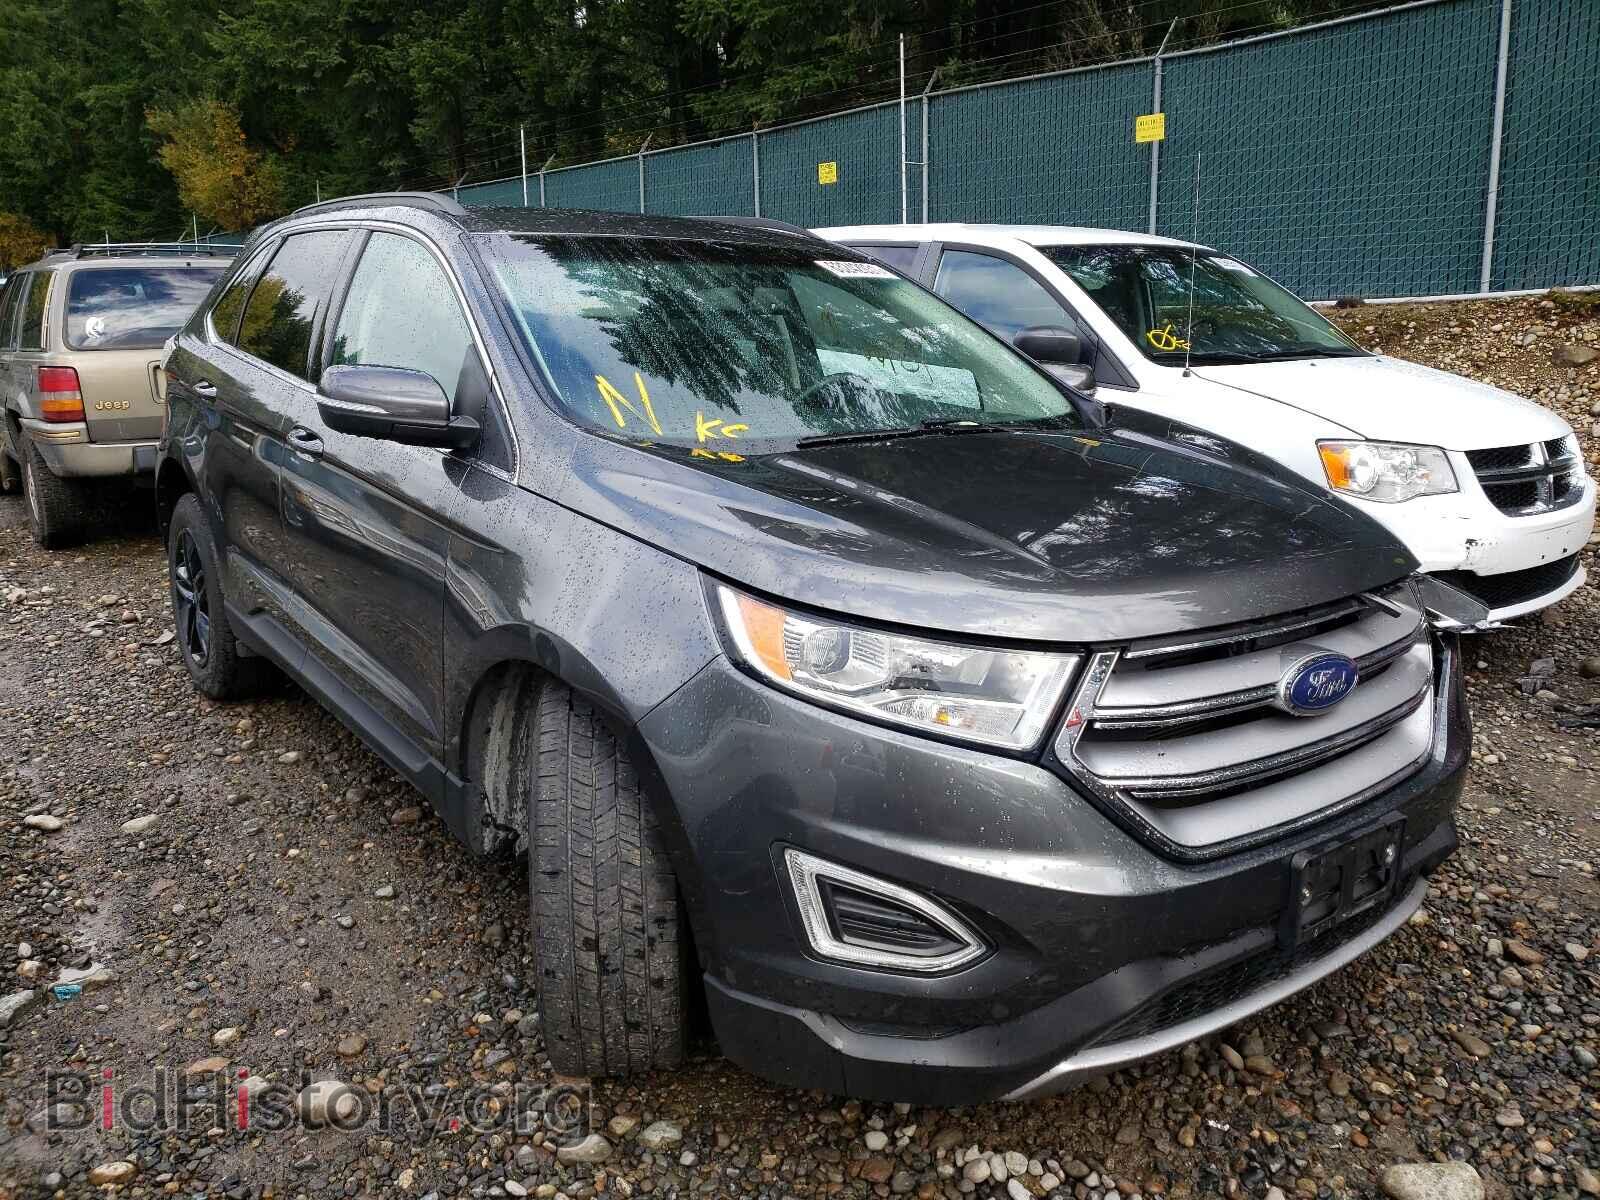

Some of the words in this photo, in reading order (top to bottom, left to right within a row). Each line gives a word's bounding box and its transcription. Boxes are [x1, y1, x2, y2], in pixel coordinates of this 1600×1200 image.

[95, 400, 130, 411] Jeep
[595, 372, 663, 437] N
[1307, 667, 1348, 703] Ford
